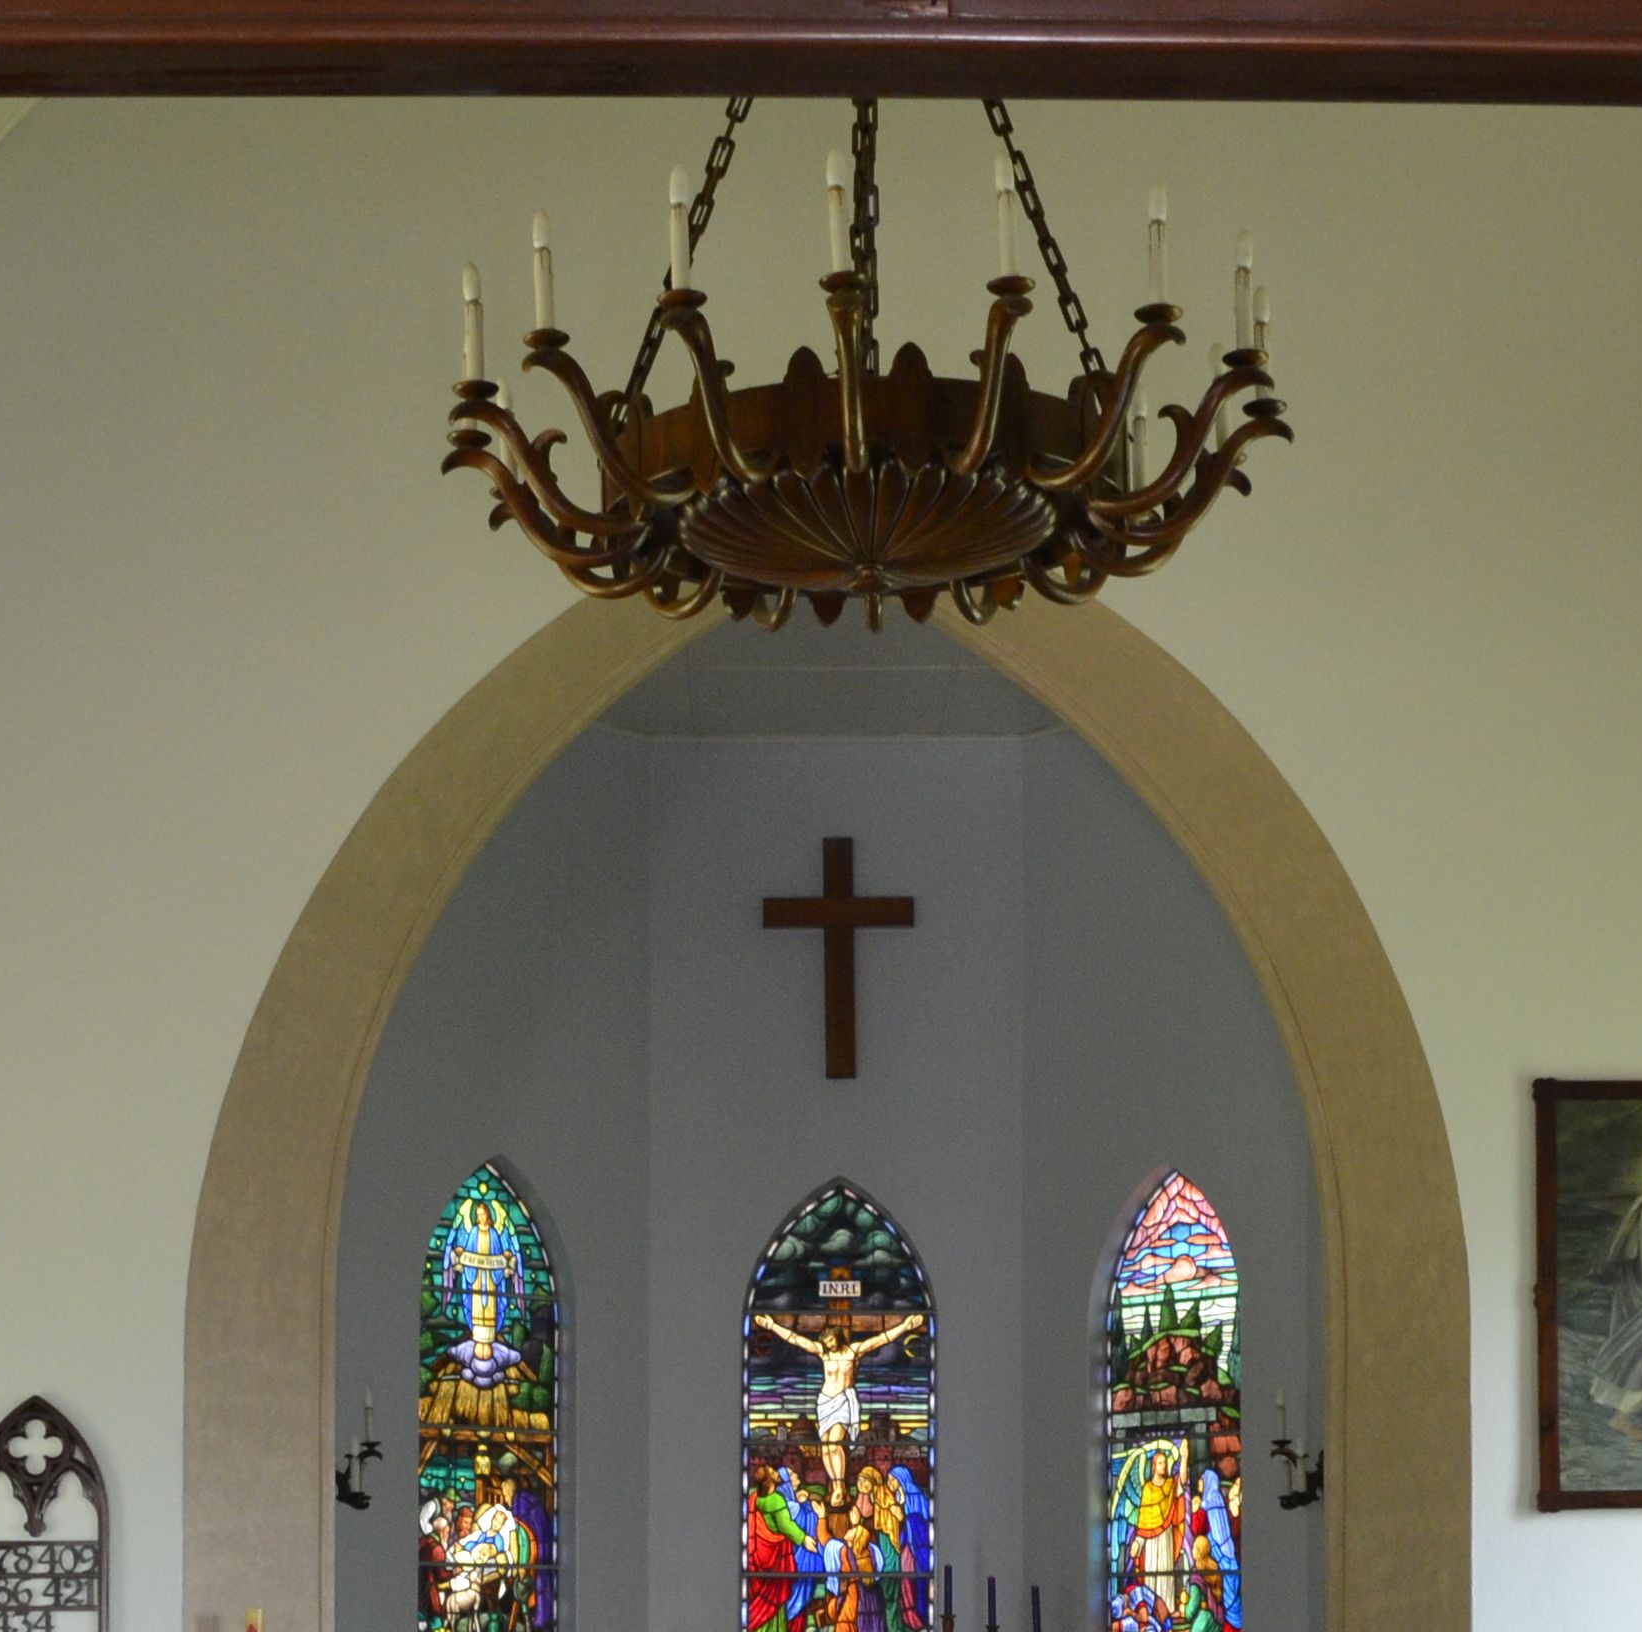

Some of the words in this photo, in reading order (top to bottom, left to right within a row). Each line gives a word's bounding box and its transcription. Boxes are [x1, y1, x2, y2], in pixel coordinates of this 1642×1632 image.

[822, 1283, 856, 1295] INRI
[38, 1545, 97, 1574] 409
[42, 1578, 95, 1607] 421
